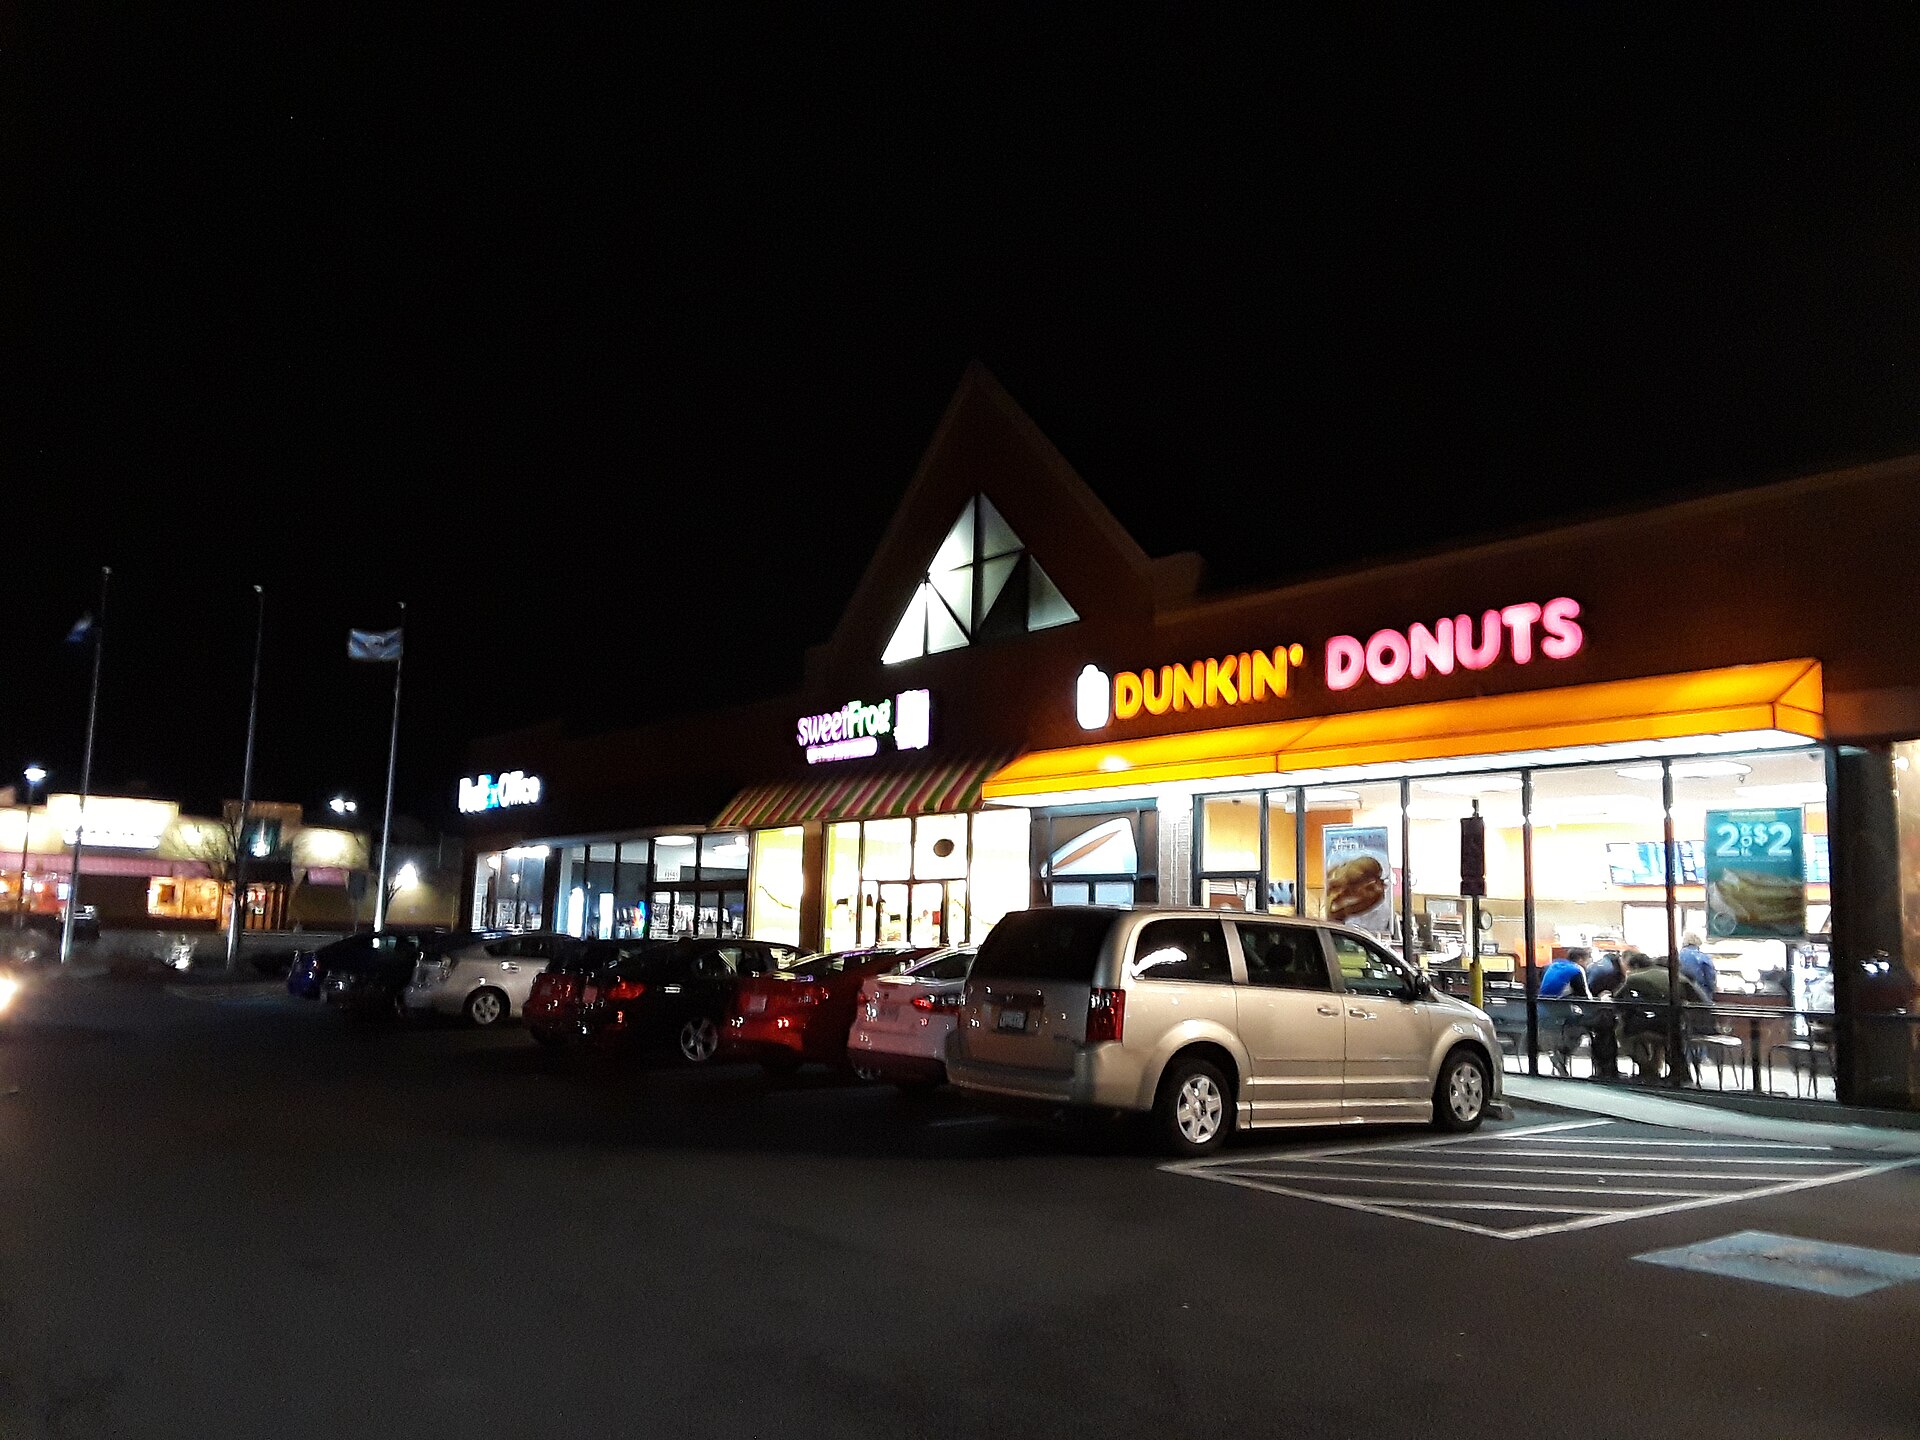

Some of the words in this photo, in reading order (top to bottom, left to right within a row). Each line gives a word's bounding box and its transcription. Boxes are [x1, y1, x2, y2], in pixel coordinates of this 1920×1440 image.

[1113, 643, 1304, 720] DUNKIN'
[1324, 596, 1585, 692] DONUTS
[1716, 822, 1740, 857] 2
